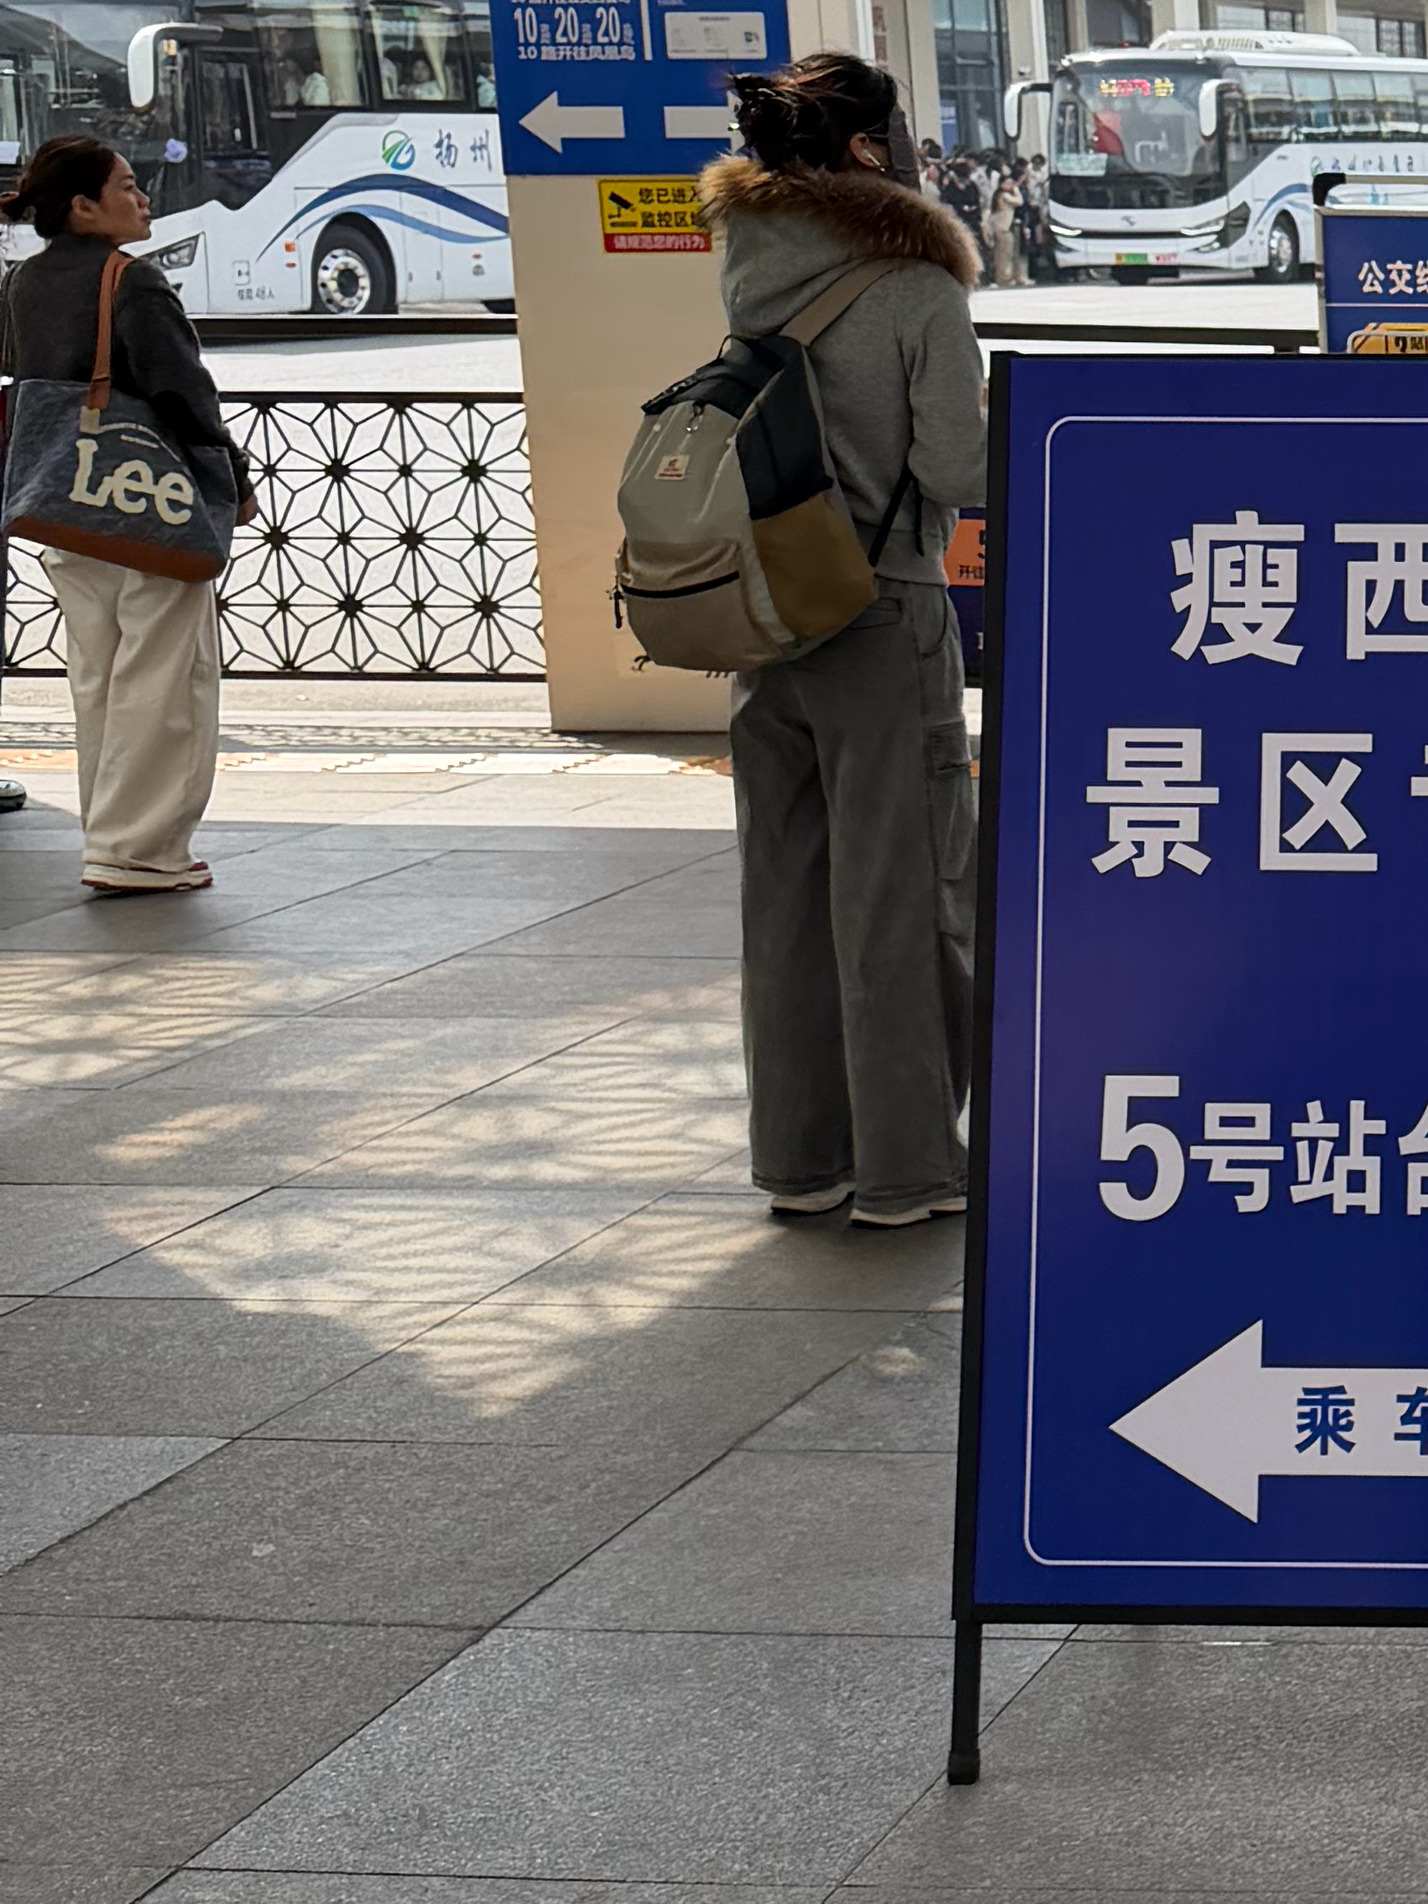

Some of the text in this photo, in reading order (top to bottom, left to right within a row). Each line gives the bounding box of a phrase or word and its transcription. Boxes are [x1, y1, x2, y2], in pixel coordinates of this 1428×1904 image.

[641, 211, 698, 227] 监控区
[69, 438, 195, 525] Lee
